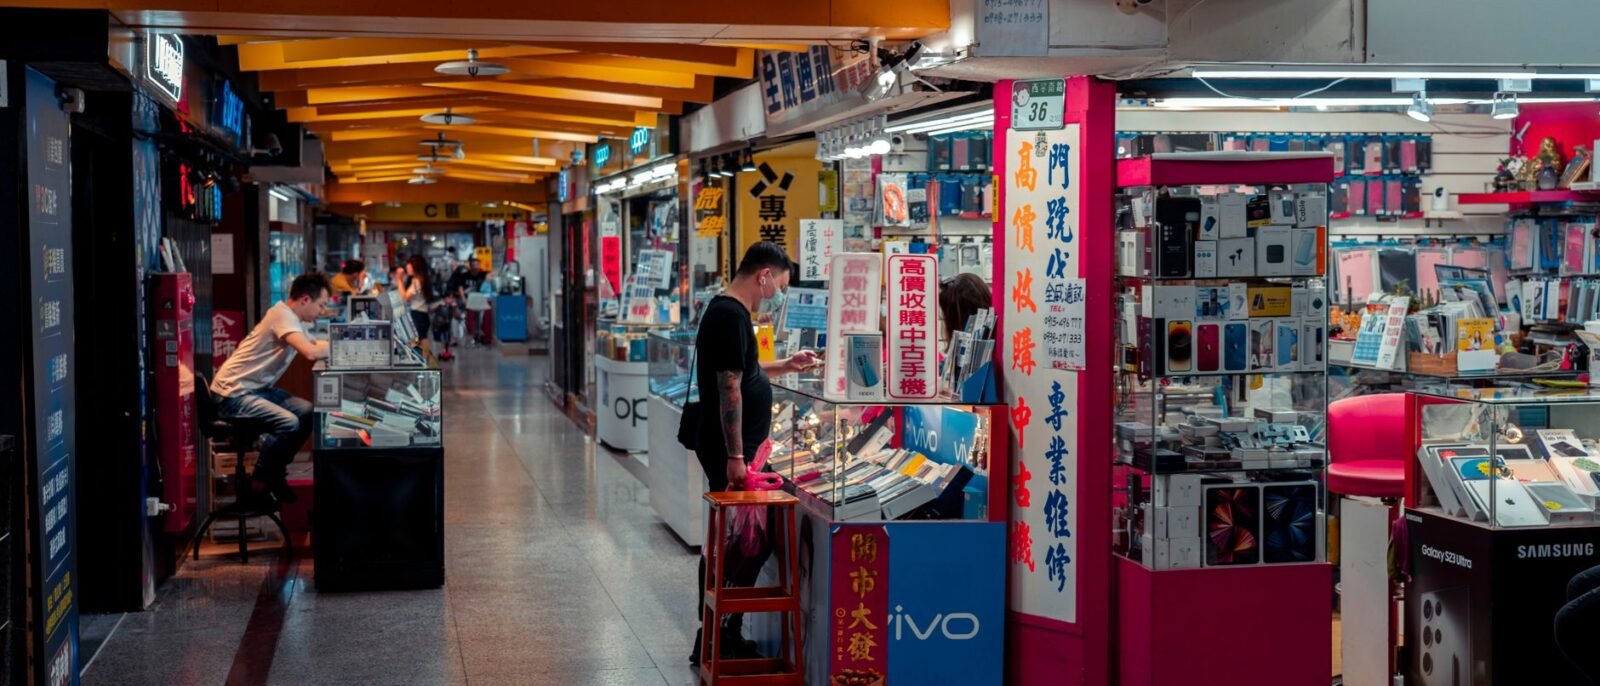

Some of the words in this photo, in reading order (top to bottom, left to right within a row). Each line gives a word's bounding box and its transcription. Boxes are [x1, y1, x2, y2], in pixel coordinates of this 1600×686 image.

[1028, 102, 1048, 121] 36
[424, 204, 438, 218] C
[900, 259, 926, 395] 高價收購中古手機
[912, 421, 938, 452] vivo
[1044, 381, 1071, 592] 專業維修
[1421, 544, 1445, 563] Galaxy
[1444, 551, 1456, 563] S23
[1456, 555, 1472, 569] Ultra
[1517, 543, 1594, 558] SAMSUNG
[848, 533, 878, 661] 開市大發
[888, 605, 980, 640] ivo
